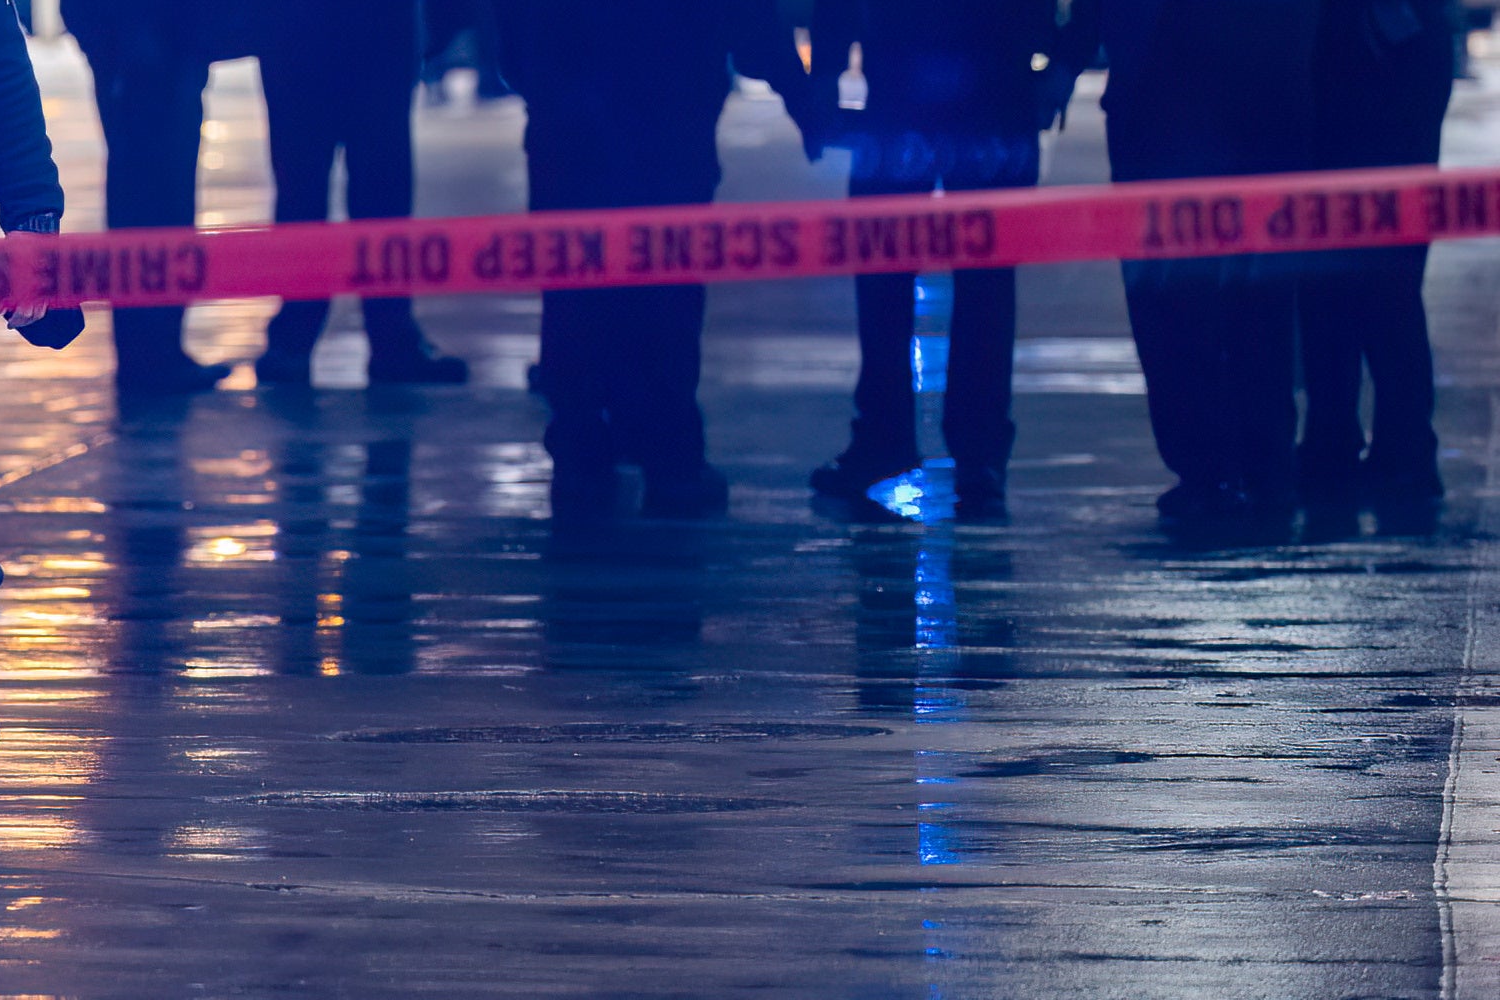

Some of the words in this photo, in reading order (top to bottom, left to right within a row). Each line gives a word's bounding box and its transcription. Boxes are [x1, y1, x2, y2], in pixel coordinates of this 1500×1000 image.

[823, 207, 994, 267] CRIME
[1143, 195, 1244, 247] OUT
[1266, 188, 1399, 240] KEEP
[33, 244, 205, 298] CRIME
[350, 233, 450, 284] OUT
[473, 226, 605, 279] KEEP
[628, 217, 800, 274] SCENE
